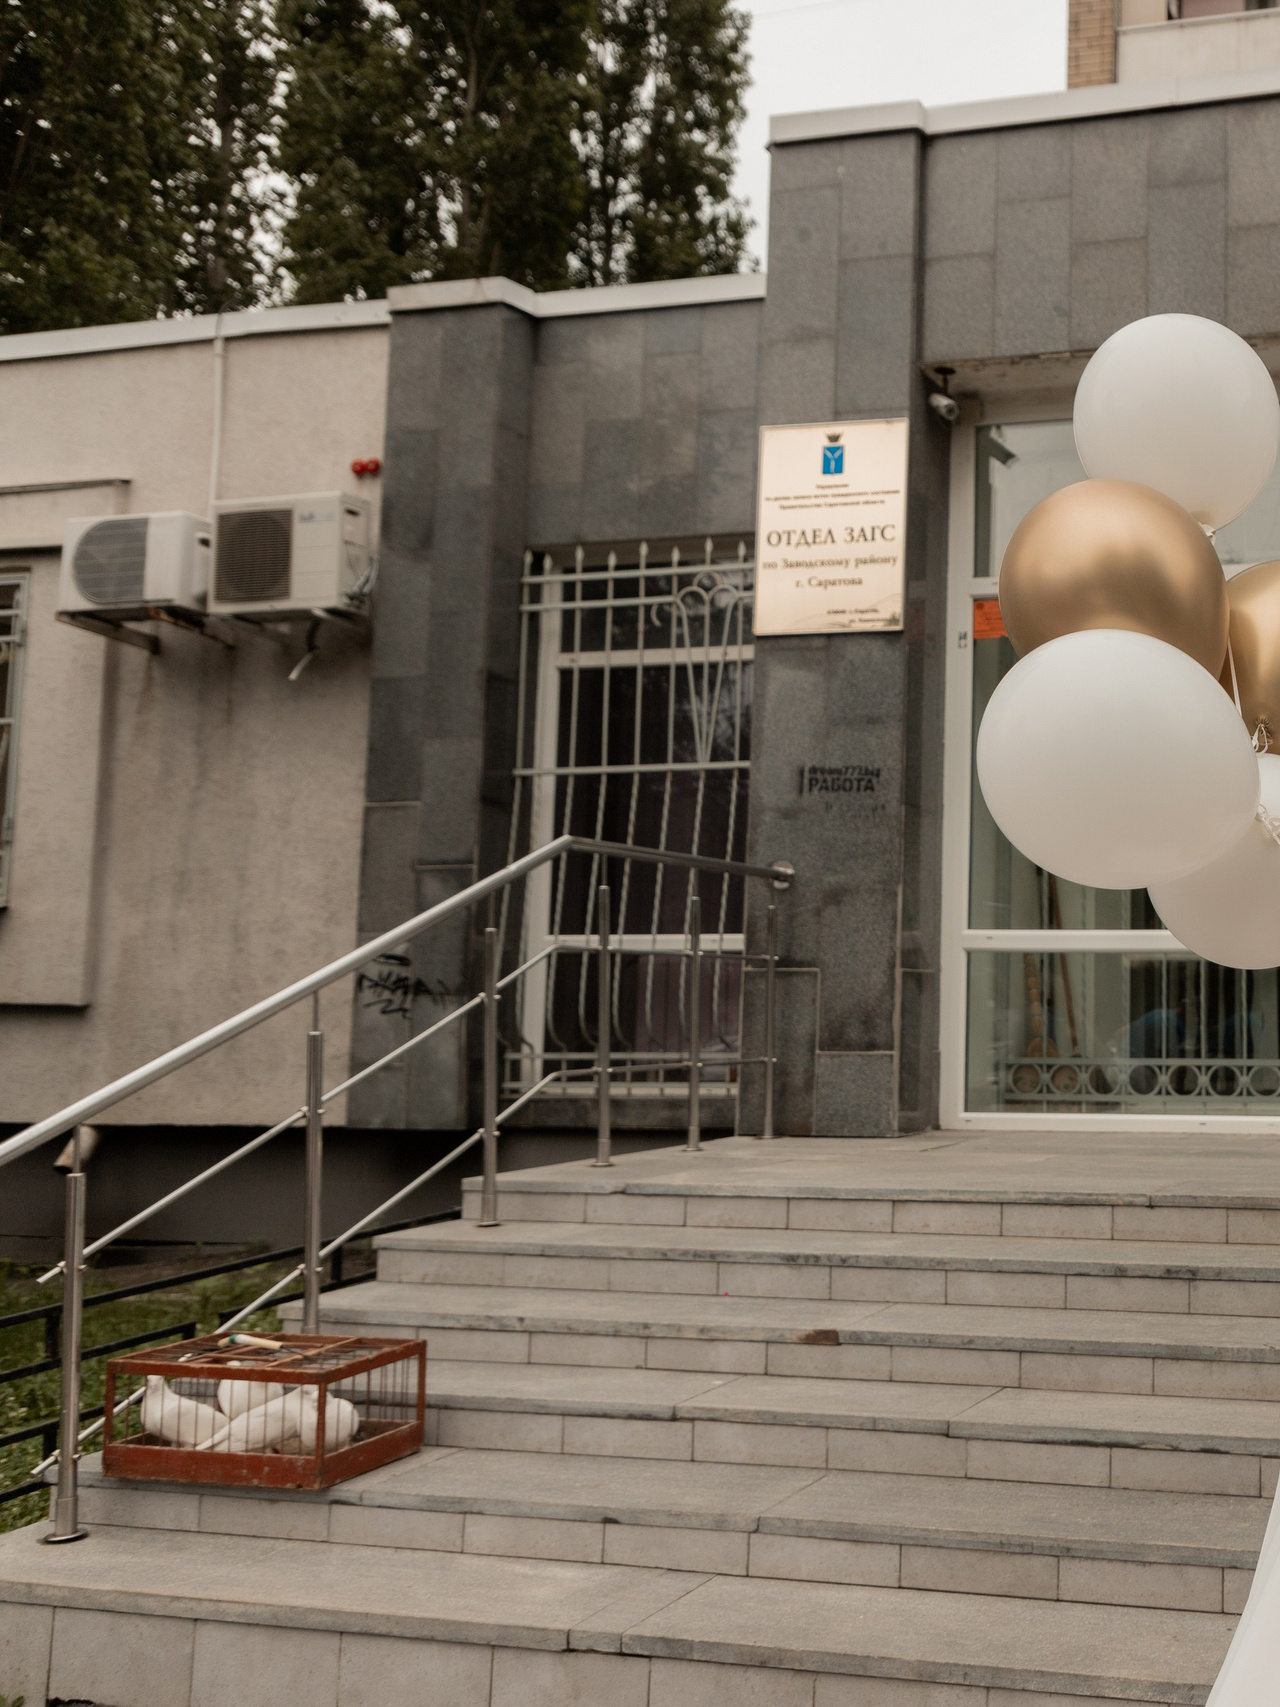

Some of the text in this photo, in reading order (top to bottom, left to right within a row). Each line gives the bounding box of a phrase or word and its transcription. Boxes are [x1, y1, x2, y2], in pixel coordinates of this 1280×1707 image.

[766, 524, 896, 548] ОТДЕЛ ЗАГС
[762, 554, 898, 569] по Заводскому району
[807, 575, 863, 589] Саратова
[808, 777, 875, 793] РАБОТА
